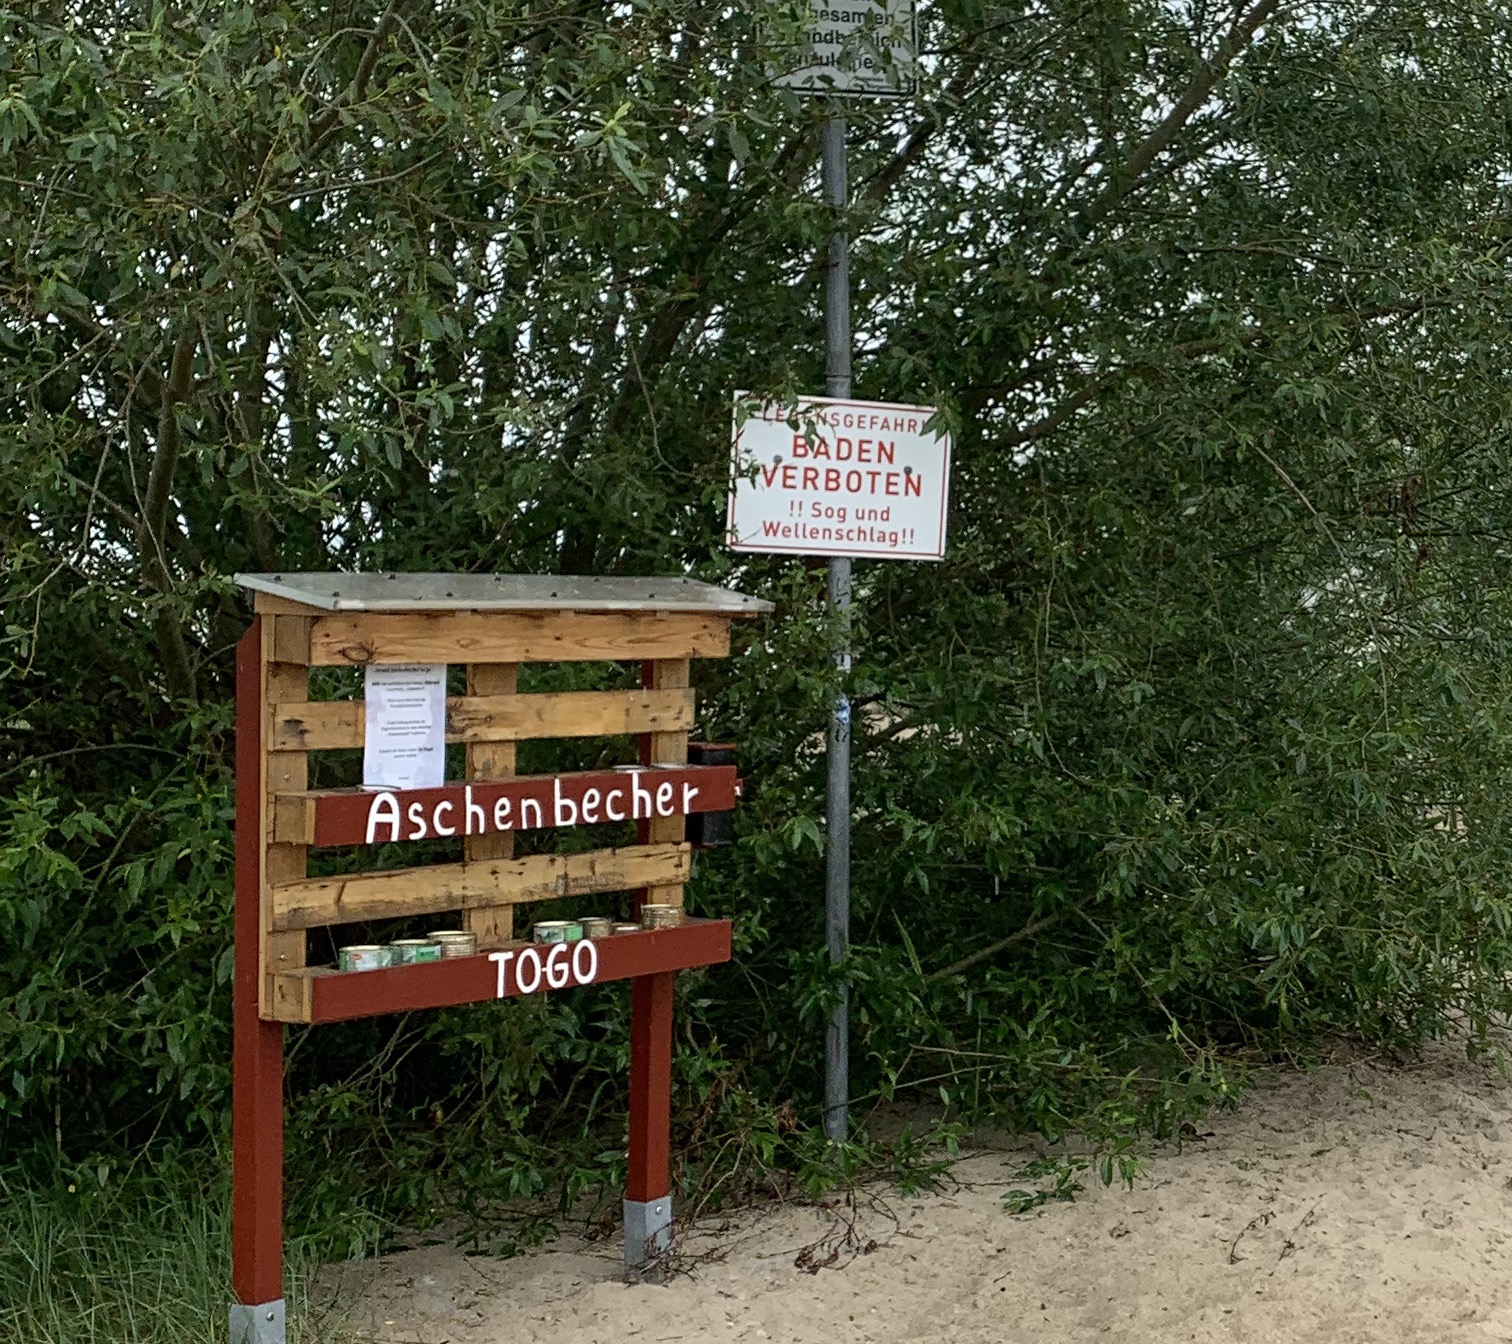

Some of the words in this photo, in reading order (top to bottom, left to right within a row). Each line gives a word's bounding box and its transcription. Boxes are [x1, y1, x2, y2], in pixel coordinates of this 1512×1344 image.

[792, 434, 896, 465] BADEN
[762, 464, 922, 497] VERBOTEN
[811, 501, 847, 523] Sog
[855, 506, 891, 522] und
[762, 520, 915, 547] Wellenschlag!!
[365, 772, 700, 844] Aschenbecher
